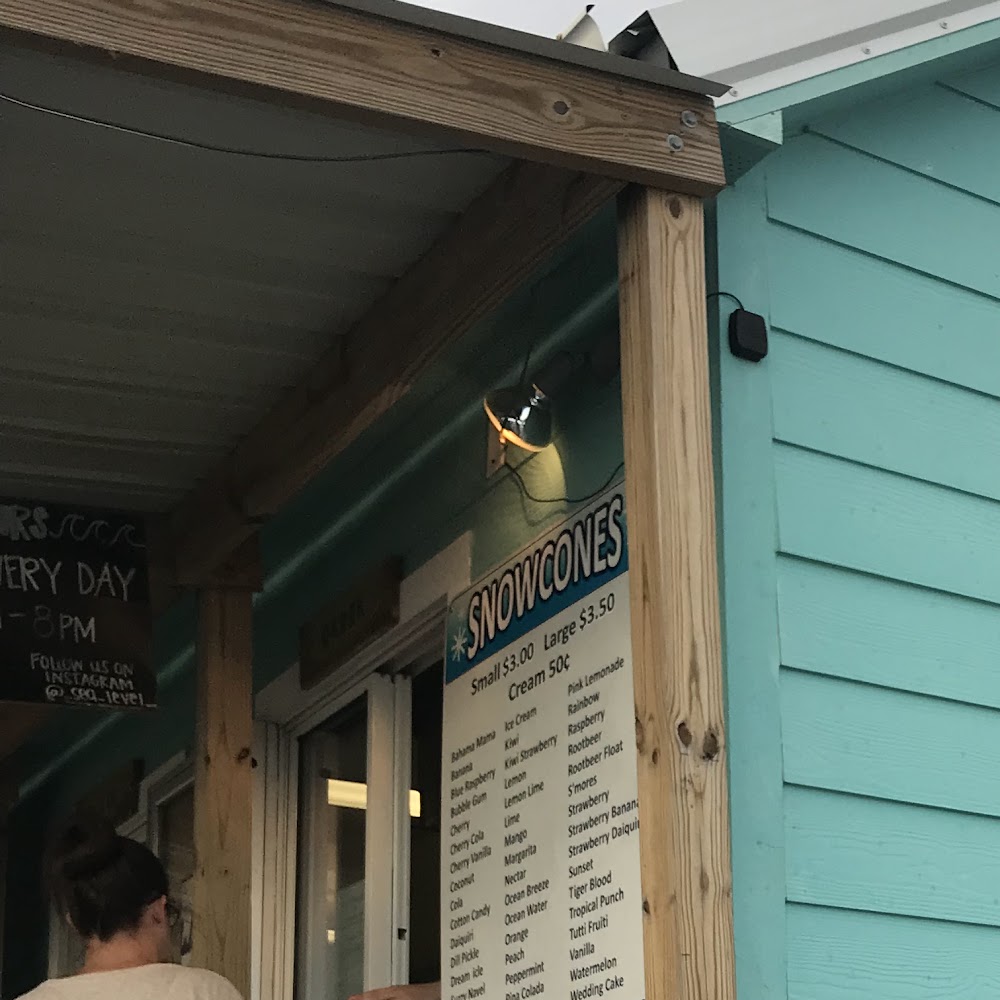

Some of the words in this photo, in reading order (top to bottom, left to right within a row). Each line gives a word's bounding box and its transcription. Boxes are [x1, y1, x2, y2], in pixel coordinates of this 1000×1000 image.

[0, 554, 61, 595] ERY
[77, 561, 136, 602] DAY
[466, 494, 623, 661] SNOWCONES
[471, 662, 500, 696] Small
[502, 642, 534, 677] $3.00
[544, 621, 576, 651] Large
[579, 592, 615, 630] $3.50
[45, 670, 134, 691] INSTAGRAM
[89, 659, 109, 674] US
[113, 662, 134, 678] ON
[509, 669, 545, 701] Cream
[549, 653, 570, 678] 50¢
[567, 677, 584, 697] Pink
[584, 655, 625, 687] Lemonade
[567, 691, 600, 716] Rainbow
[504, 720, 514, 732] Ice
[516, 707, 537, 726] Cream
[567, 709, 605, 737] Raspberry
[476, 730, 496, 749] Mama
[504, 733, 519, 751] Kiwi
[567, 730, 602, 757] Rootbeer
[504, 752, 519, 770] Kiwi
[520, 734, 558, 762] Strawberry
[567, 752, 602, 777] Rootbeer
[603, 739, 624, 760] Float
[465, 768, 496, 791] Raspberry
[504, 771, 527, 789] Lemon
[567, 774, 598, 798] S'mores
[450, 799, 471, 818] Bubble
[472, 792, 487, 806] Gum
[504, 790, 527, 809] Lemon
[527, 781, 544, 797] Lime
[567, 789, 610, 818] Strawberry
[450, 820, 470, 836] Cherry
[504, 813, 520, 828] Lime
[568, 810, 610, 838] Strawberry
[450, 839, 470, 855] Cherry
[470, 830, 484, 845] Cola
[504, 829, 528, 847] Mango
[568, 831, 610, 859] Strawberry
[450, 858, 470, 874] Cherry
[470, 845, 492, 863] Vanilla
[504, 844, 537, 867] Margarita
[504, 869, 527, 887] Nectar
[568, 858, 594, 879] Sunset
[450, 873, 475, 893] Coconut
[504, 890, 525, 906] Ocean
[526, 879, 550, 897] Breeze
[568, 883, 588, 900] Tiger
[589, 869, 612, 891] Blood
[450, 897, 463, 912] Cola
[504, 909, 525, 926] Ocean
[526, 899, 548, 917] Water
[569, 896, 599, 919] Tropical
[600, 887, 625, 908] Punch
[450, 914, 470, 931] Cotton
[471, 903, 491, 921] Candy
[450, 928, 474, 950] Daiquiri
[504, 928, 529, 946] Orange
[569, 922, 587, 940] Tutti
[450, 954, 461, 969] Dill
[461, 947, 480, 964] Pickle
[505, 947, 525, 966] Peach
[569, 941, 595, 961] Vanilla
[450, 972, 471, 988] Dream
[505, 961, 545, 986] Peppermint
[569, 956, 617, 982] Watermelon
[468, 981, 486, 1000] Navel
[521, 981, 545, 999] Colada
[604, 975, 625, 992] Cake
